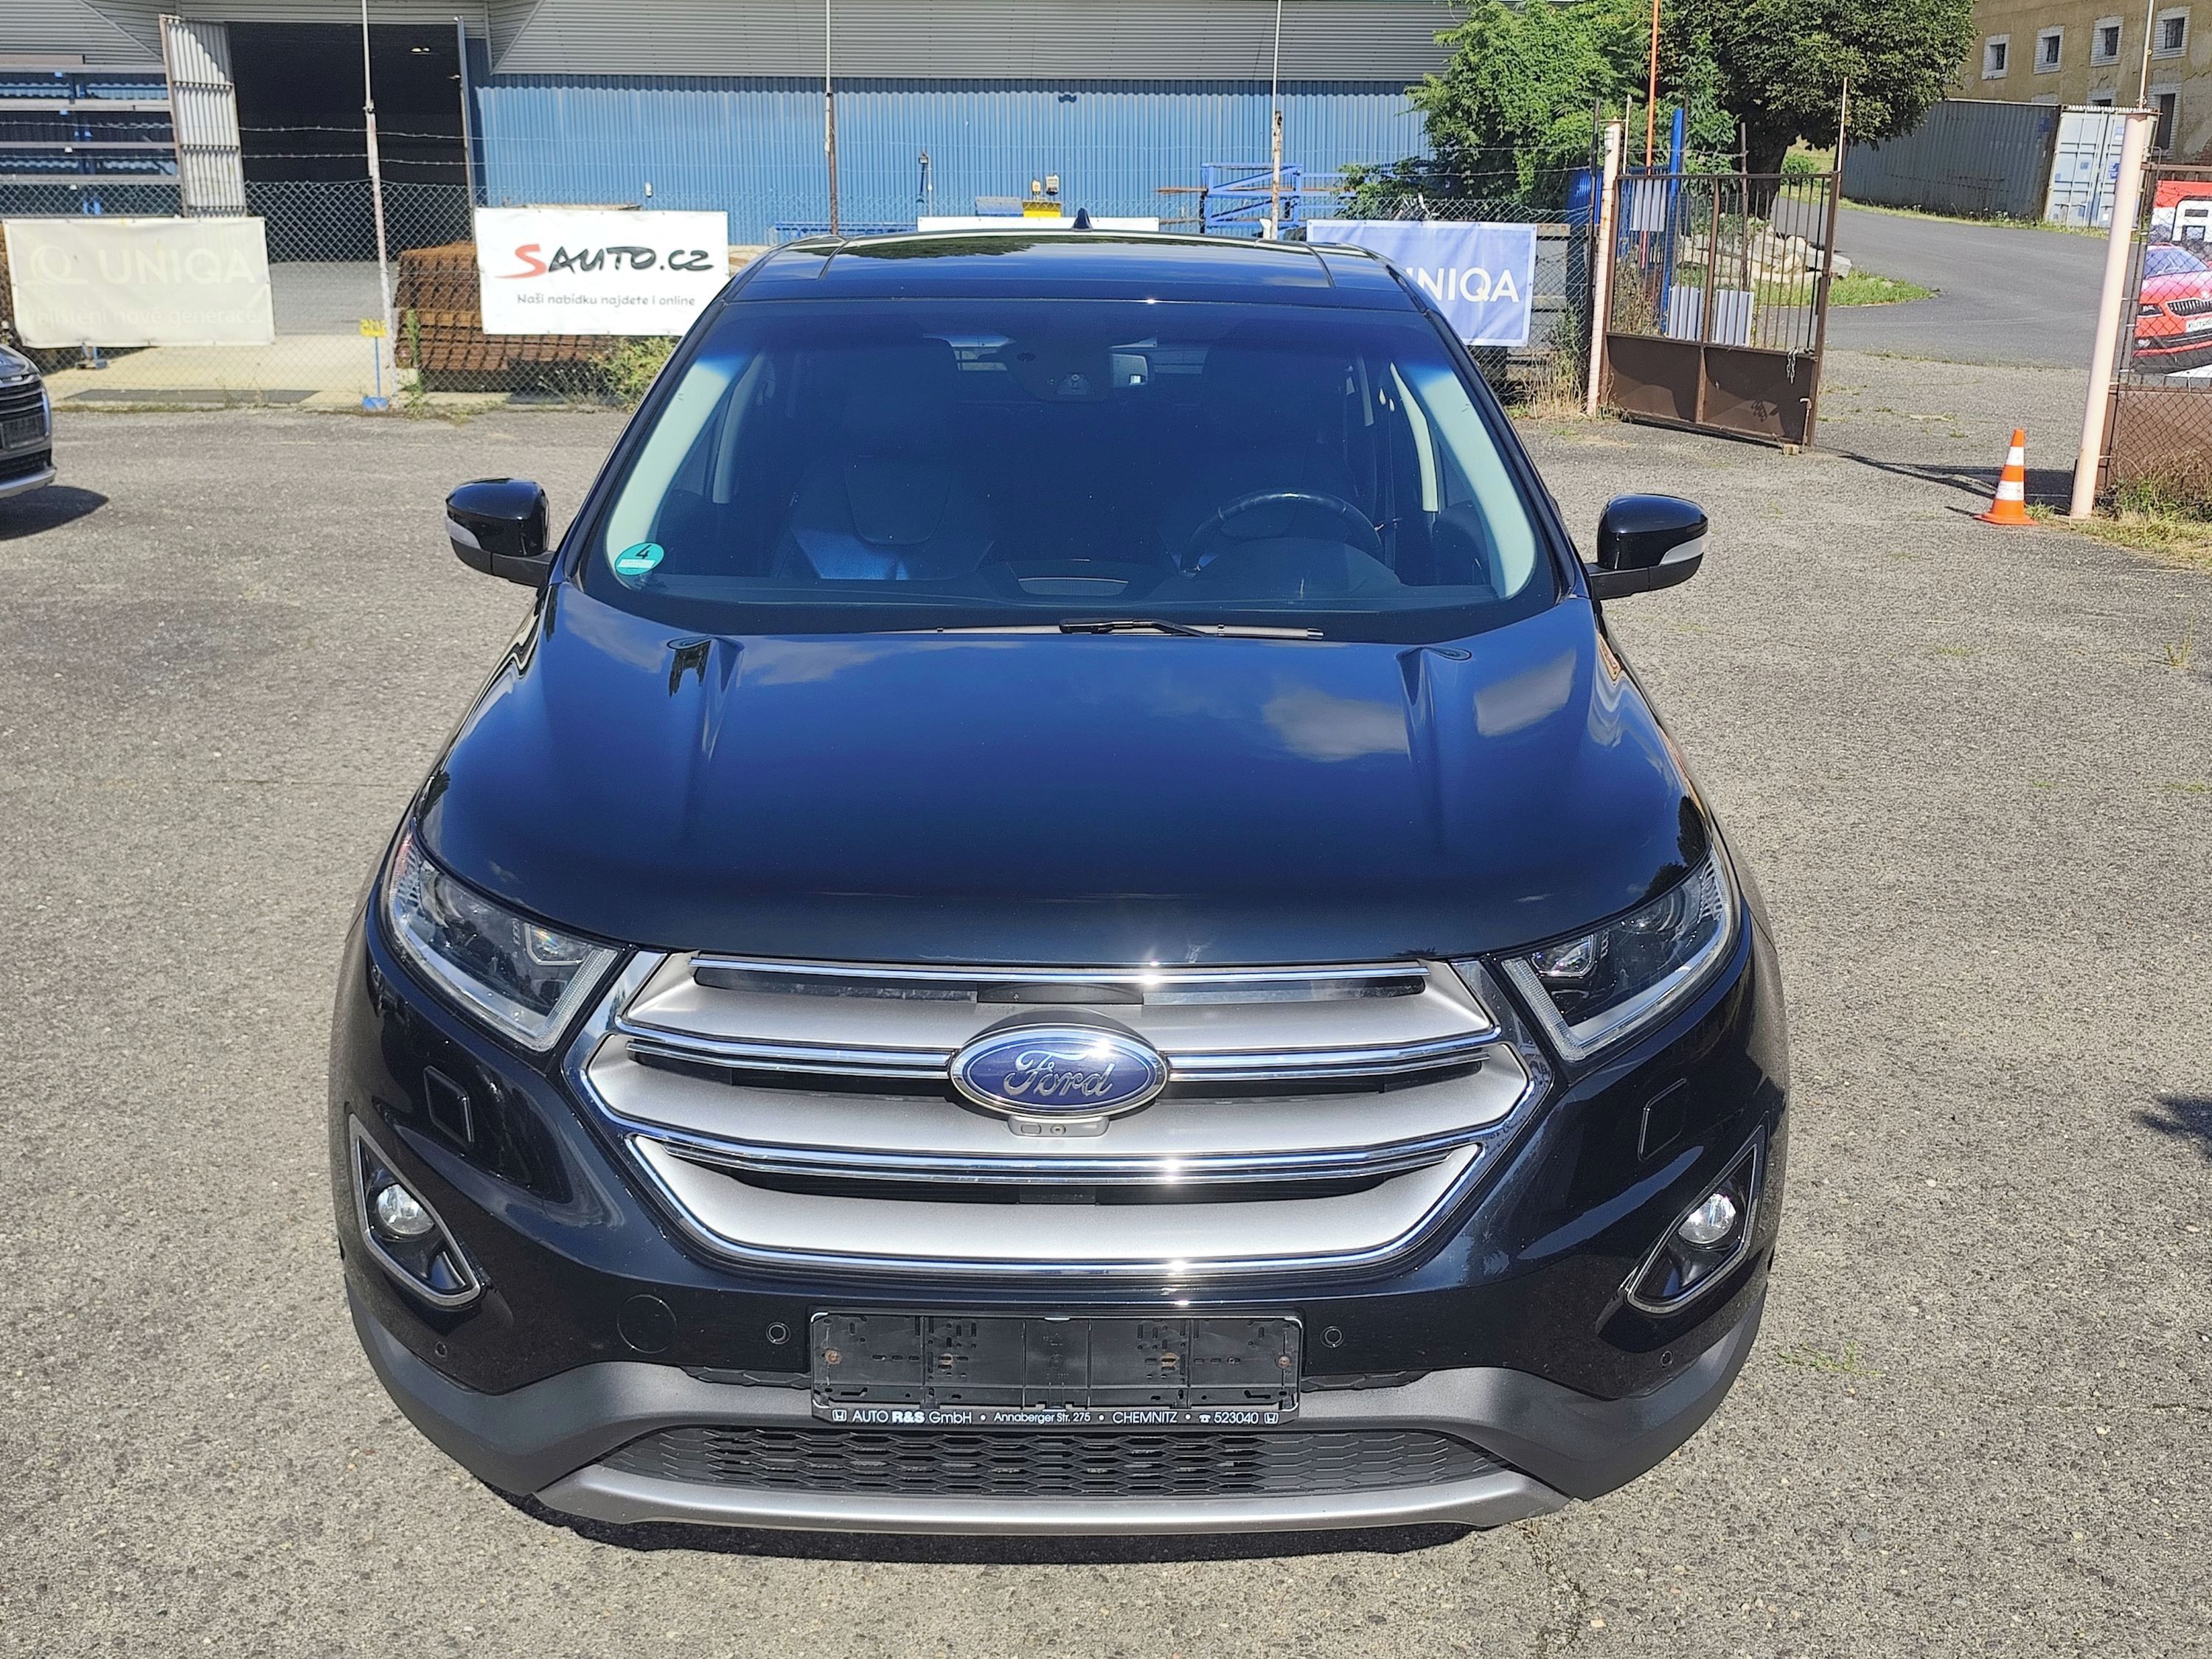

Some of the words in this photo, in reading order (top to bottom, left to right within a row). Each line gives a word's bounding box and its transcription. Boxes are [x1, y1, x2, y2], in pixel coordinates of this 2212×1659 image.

[98, 248, 256, 285] UNIQA
[1406, 267, 1520, 302] NIQA
[518, 293, 544, 304] Naší
[548, 294, 597, 305] nabídku
[601, 296, 649, 307] najdete
[659, 296, 695, 306] online
[113, 305, 164, 324] nové
[169, 309, 262, 329] generace.
[635, 544, 652, 559] 4
[1004, 1048, 1115, 1097] Ford
[852, 1410, 889, 1423] AUTO
[891, 1411, 925, 1424] R&S
[928, 1410, 972, 1424] GmbH
[993, 1412, 1054, 1425] Annaberger
[1056, 1412, 1071, 1422] Str.
[1073, 1411, 1091, 1422] 275
[1112, 1411, 1178, 1424] CHEMNITZ
[1214, 1411, 1259, 1424] 523040
